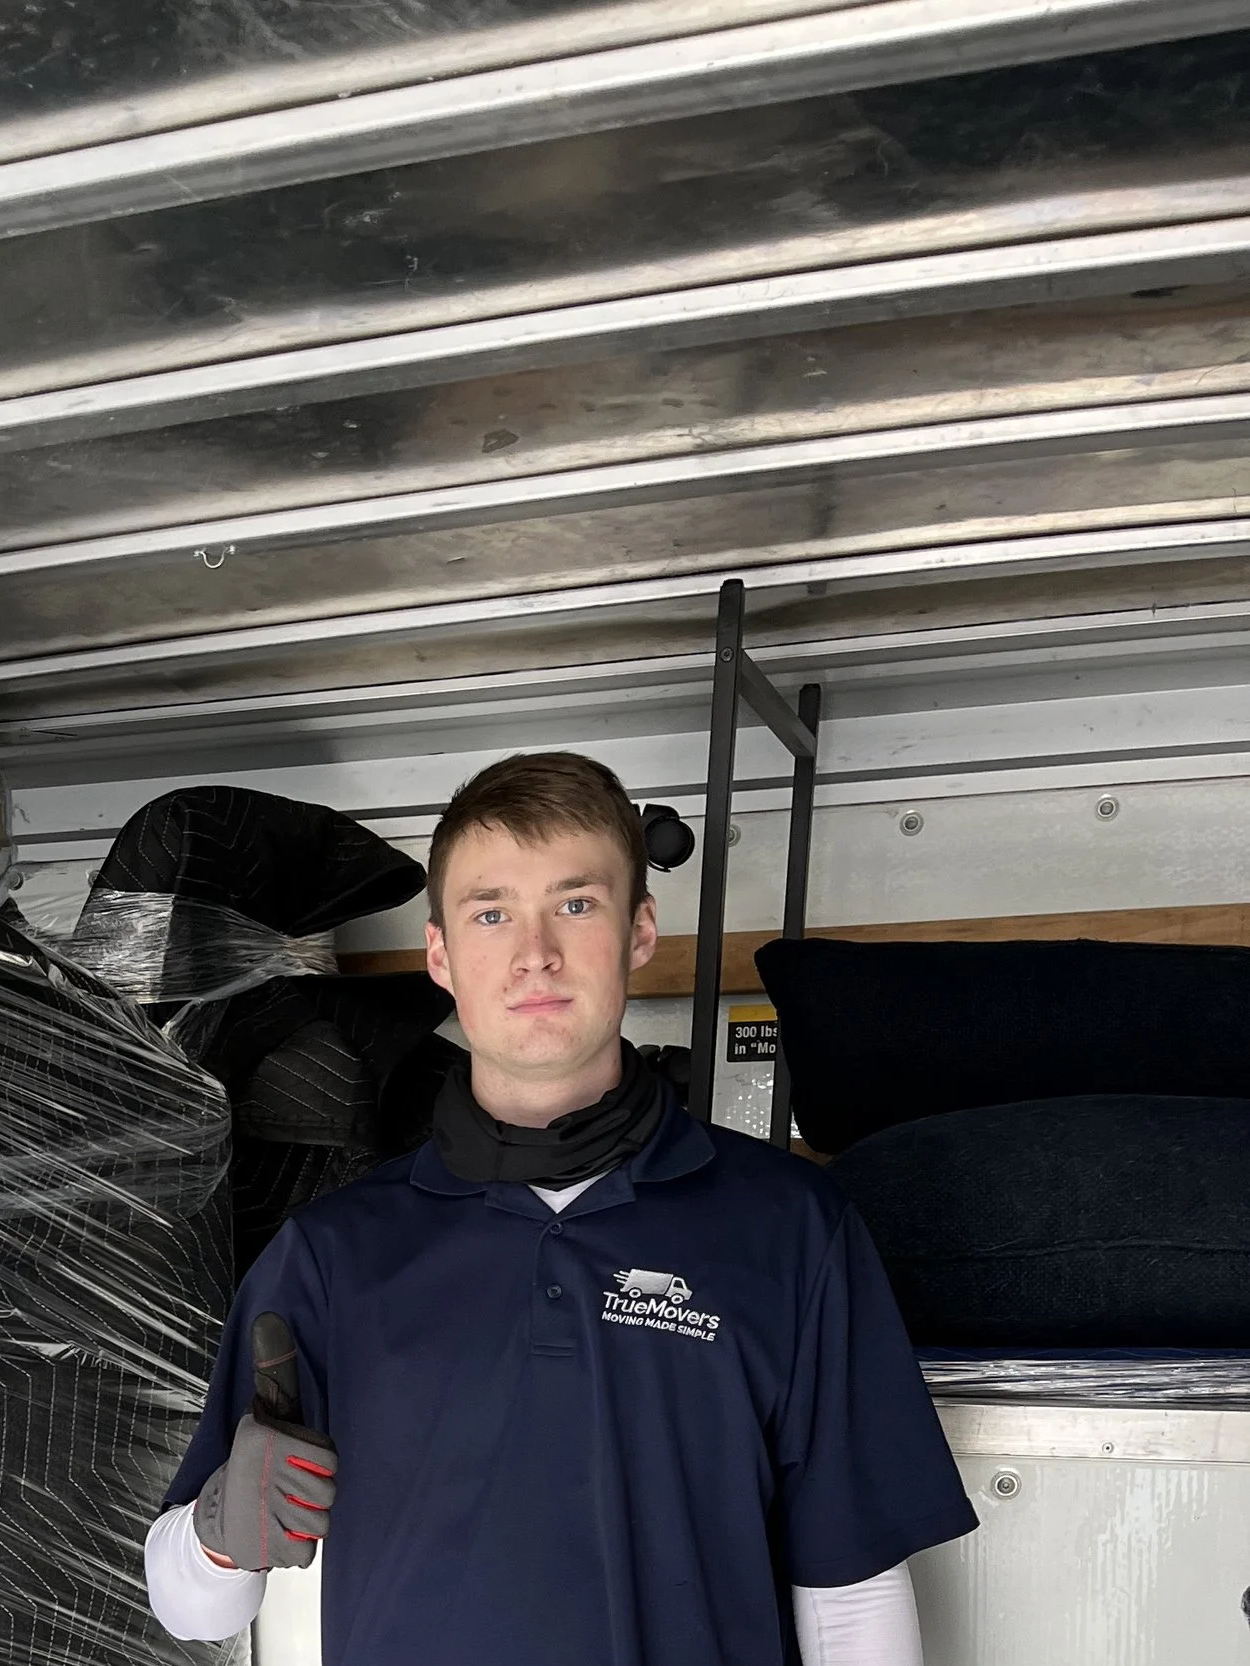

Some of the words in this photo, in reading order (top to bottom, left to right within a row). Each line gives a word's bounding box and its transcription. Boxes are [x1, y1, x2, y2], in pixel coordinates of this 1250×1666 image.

[735, 1026, 757, 1038] 300
[734, 1043, 746, 1055] in
[603, 1291, 720, 1329] TrueMovers
[602, 1311, 644, 1326] MOVING
[644, 1318, 677, 1332] MADE
[677, 1325, 715, 1342] SIMPLE
